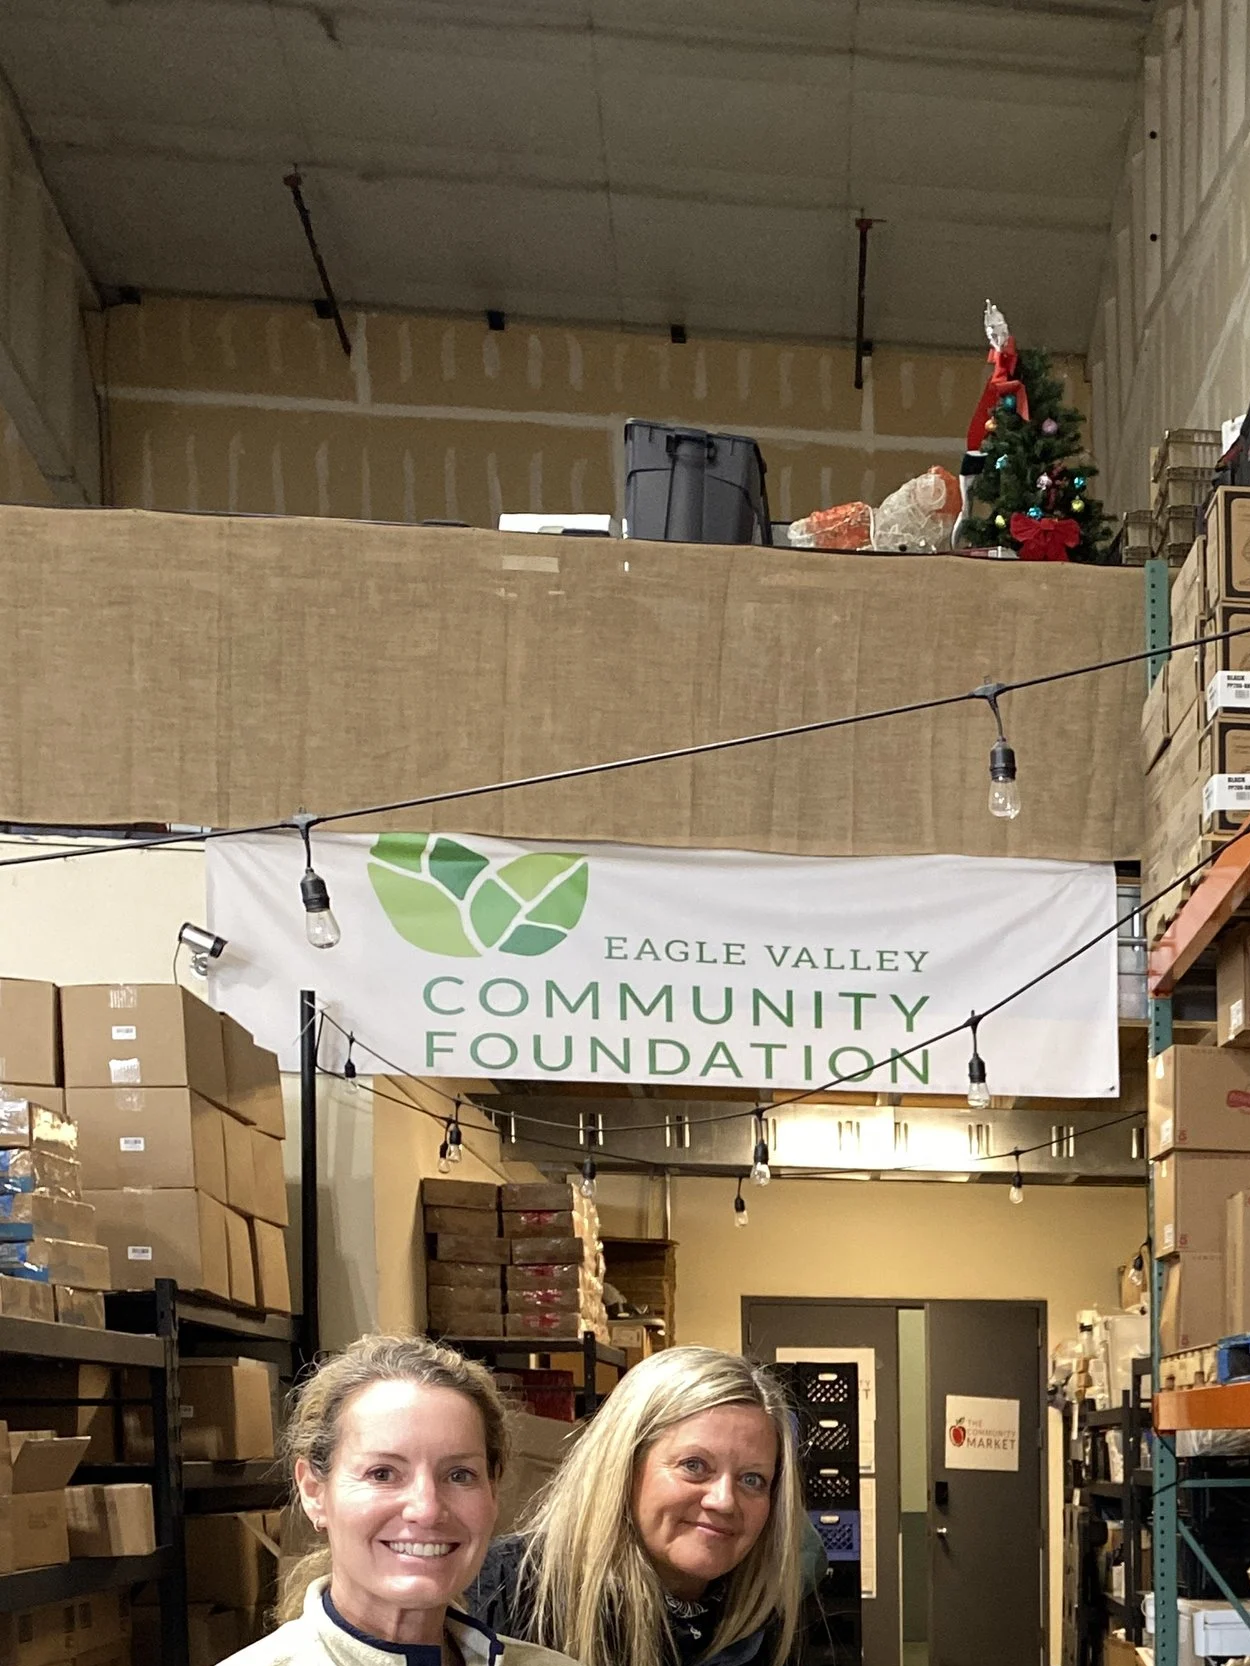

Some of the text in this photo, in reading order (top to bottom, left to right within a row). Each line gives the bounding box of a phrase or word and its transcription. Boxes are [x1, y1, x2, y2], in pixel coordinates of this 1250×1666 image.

[603, 936, 932, 975] EAGLE VALLEY
[422, 974, 933, 1034] COMMUNITY
[424, 1029, 932, 1086] FOUNDATION
[966, 1428, 1016, 1438] COMMUNITY
[968, 1419, 983, 1428] THE
[966, 1437, 1017, 1450] MARKET
